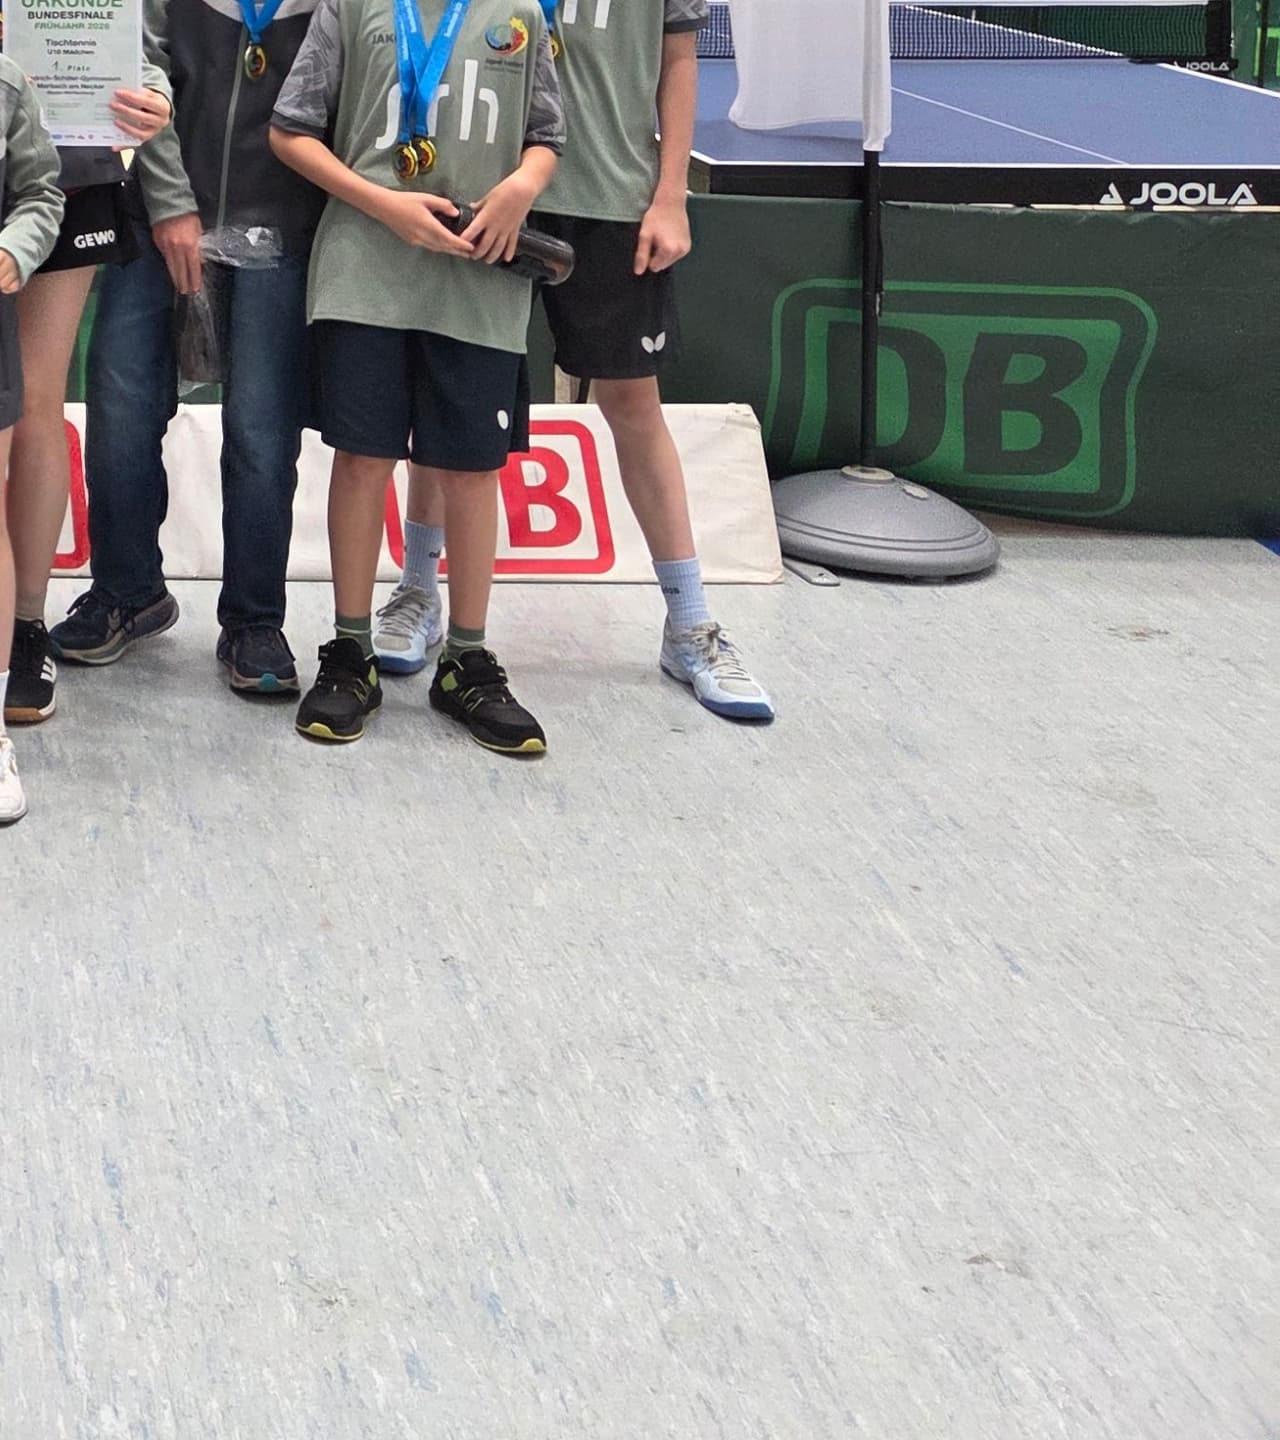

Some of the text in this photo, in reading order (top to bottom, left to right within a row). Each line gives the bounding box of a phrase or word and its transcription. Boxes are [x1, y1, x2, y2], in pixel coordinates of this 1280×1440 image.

[27, 11, 114, 20] BUNDESFINALE
[45, 38, 97, 47] Tischtennis
[1130, 182, 1259, 205] JOOLA
[73, 229, 116, 249] GEWO
[814, 321, 1084, 476] DB
